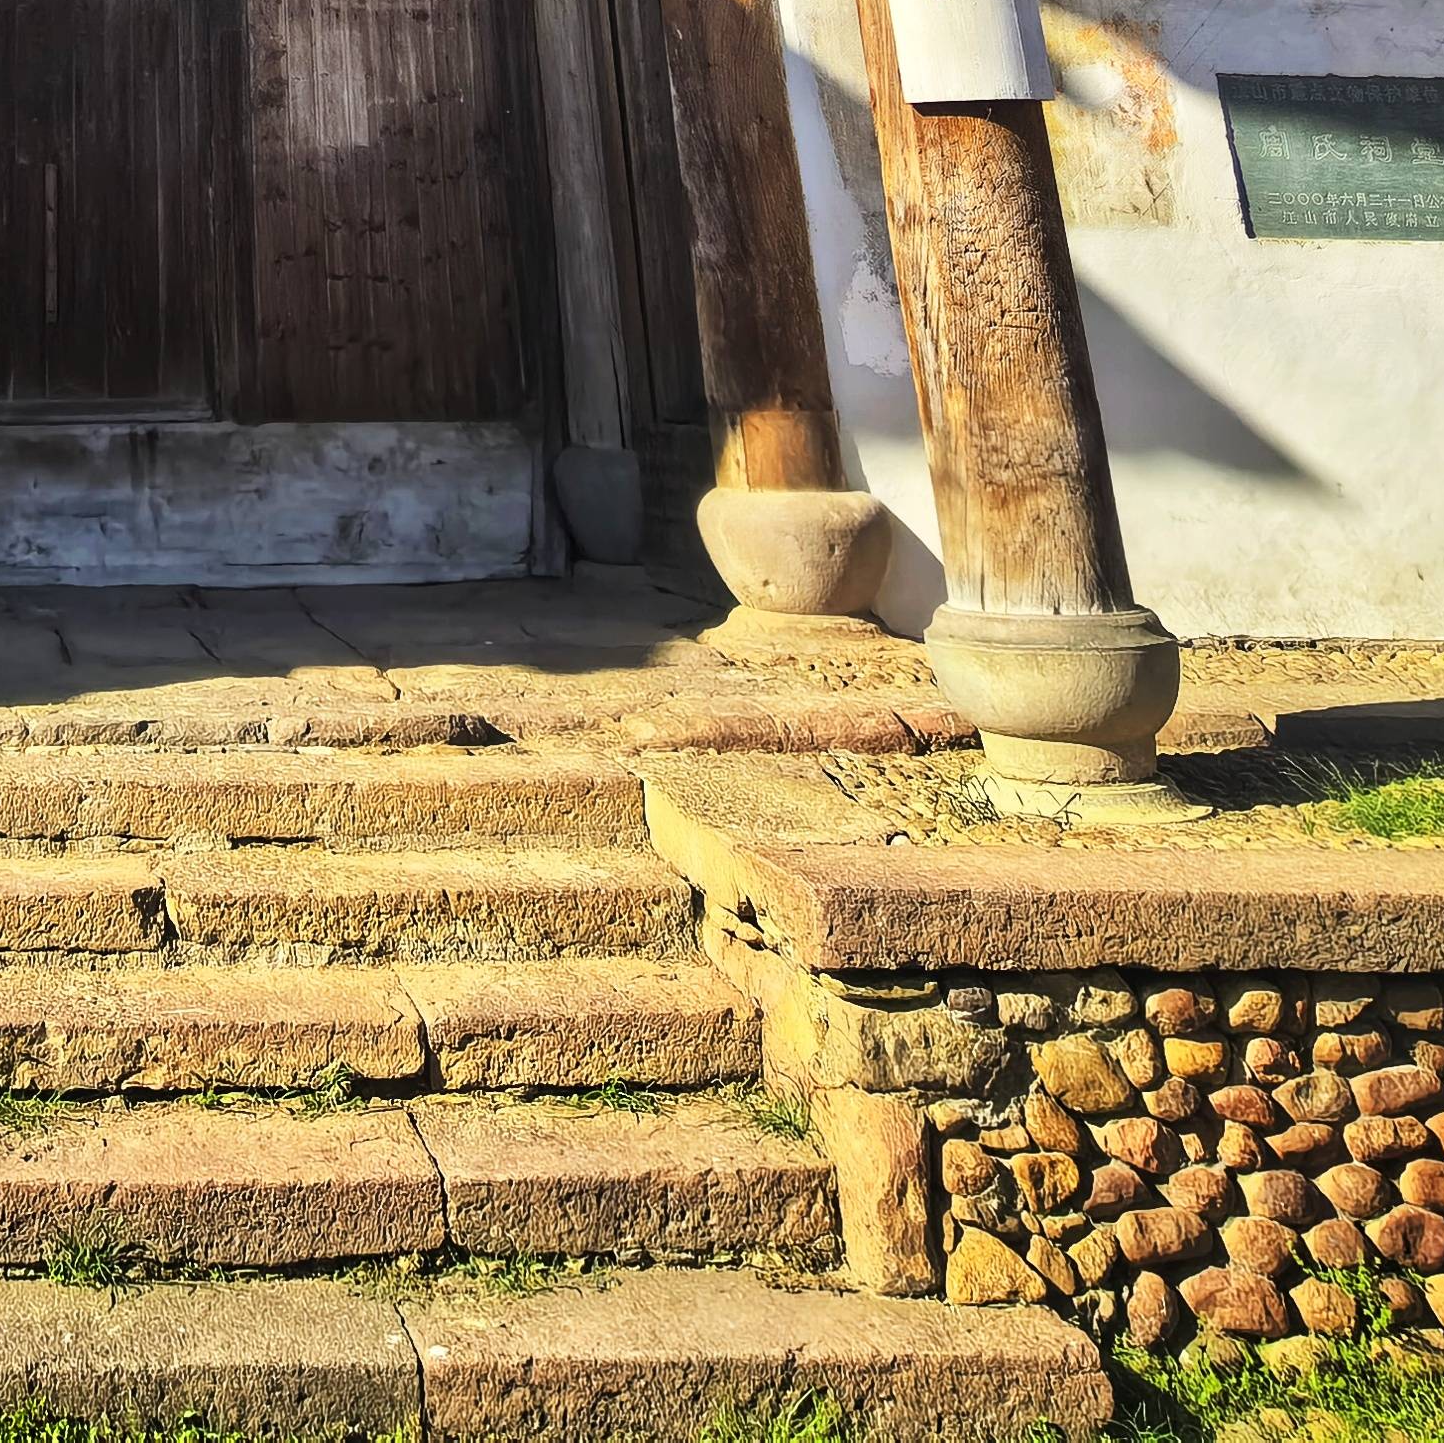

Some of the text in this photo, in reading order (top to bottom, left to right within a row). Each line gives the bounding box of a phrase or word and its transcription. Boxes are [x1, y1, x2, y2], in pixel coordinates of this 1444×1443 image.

[1281, 210, 1440, 228] 江山市人民政府立
